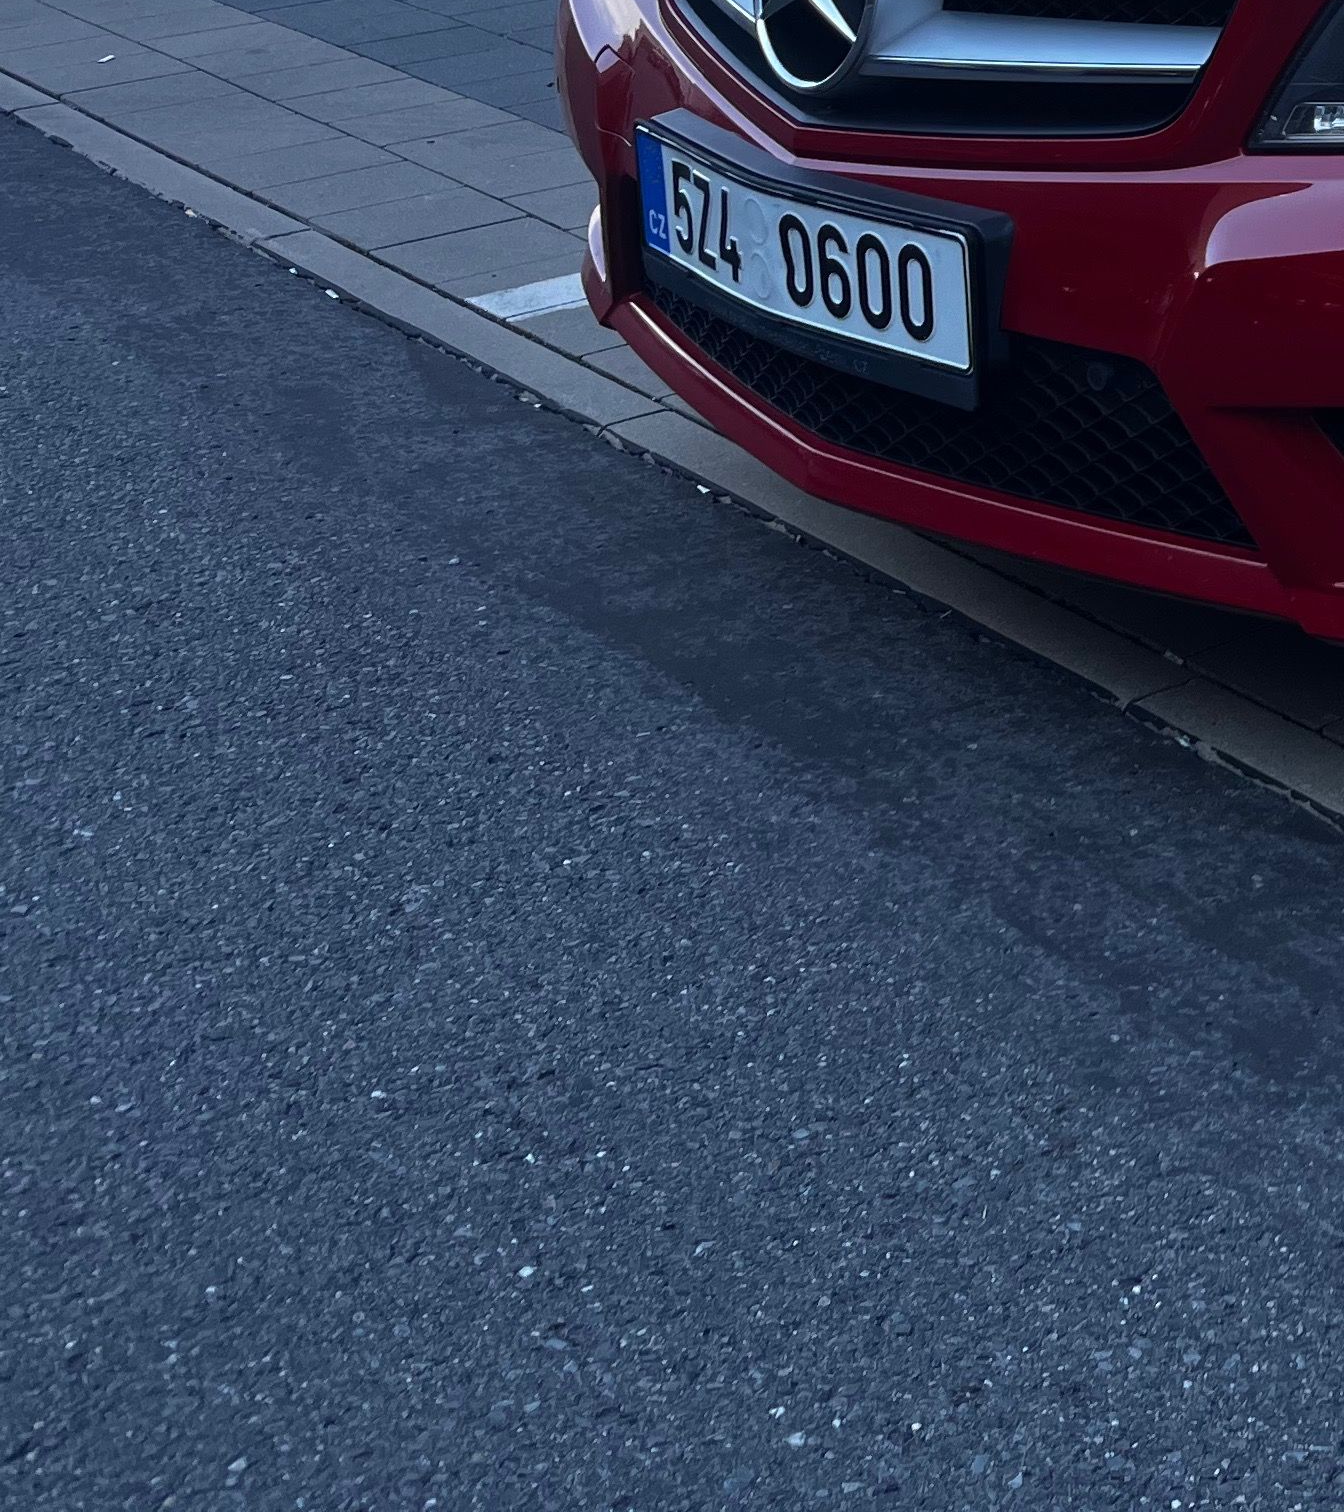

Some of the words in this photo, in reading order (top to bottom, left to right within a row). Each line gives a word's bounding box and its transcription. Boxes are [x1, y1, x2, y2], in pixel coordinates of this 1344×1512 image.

[649, 209, 667, 239] CZ
[671, 158, 742, 284] 5Z4
[778, 212, 934, 342] 0600
